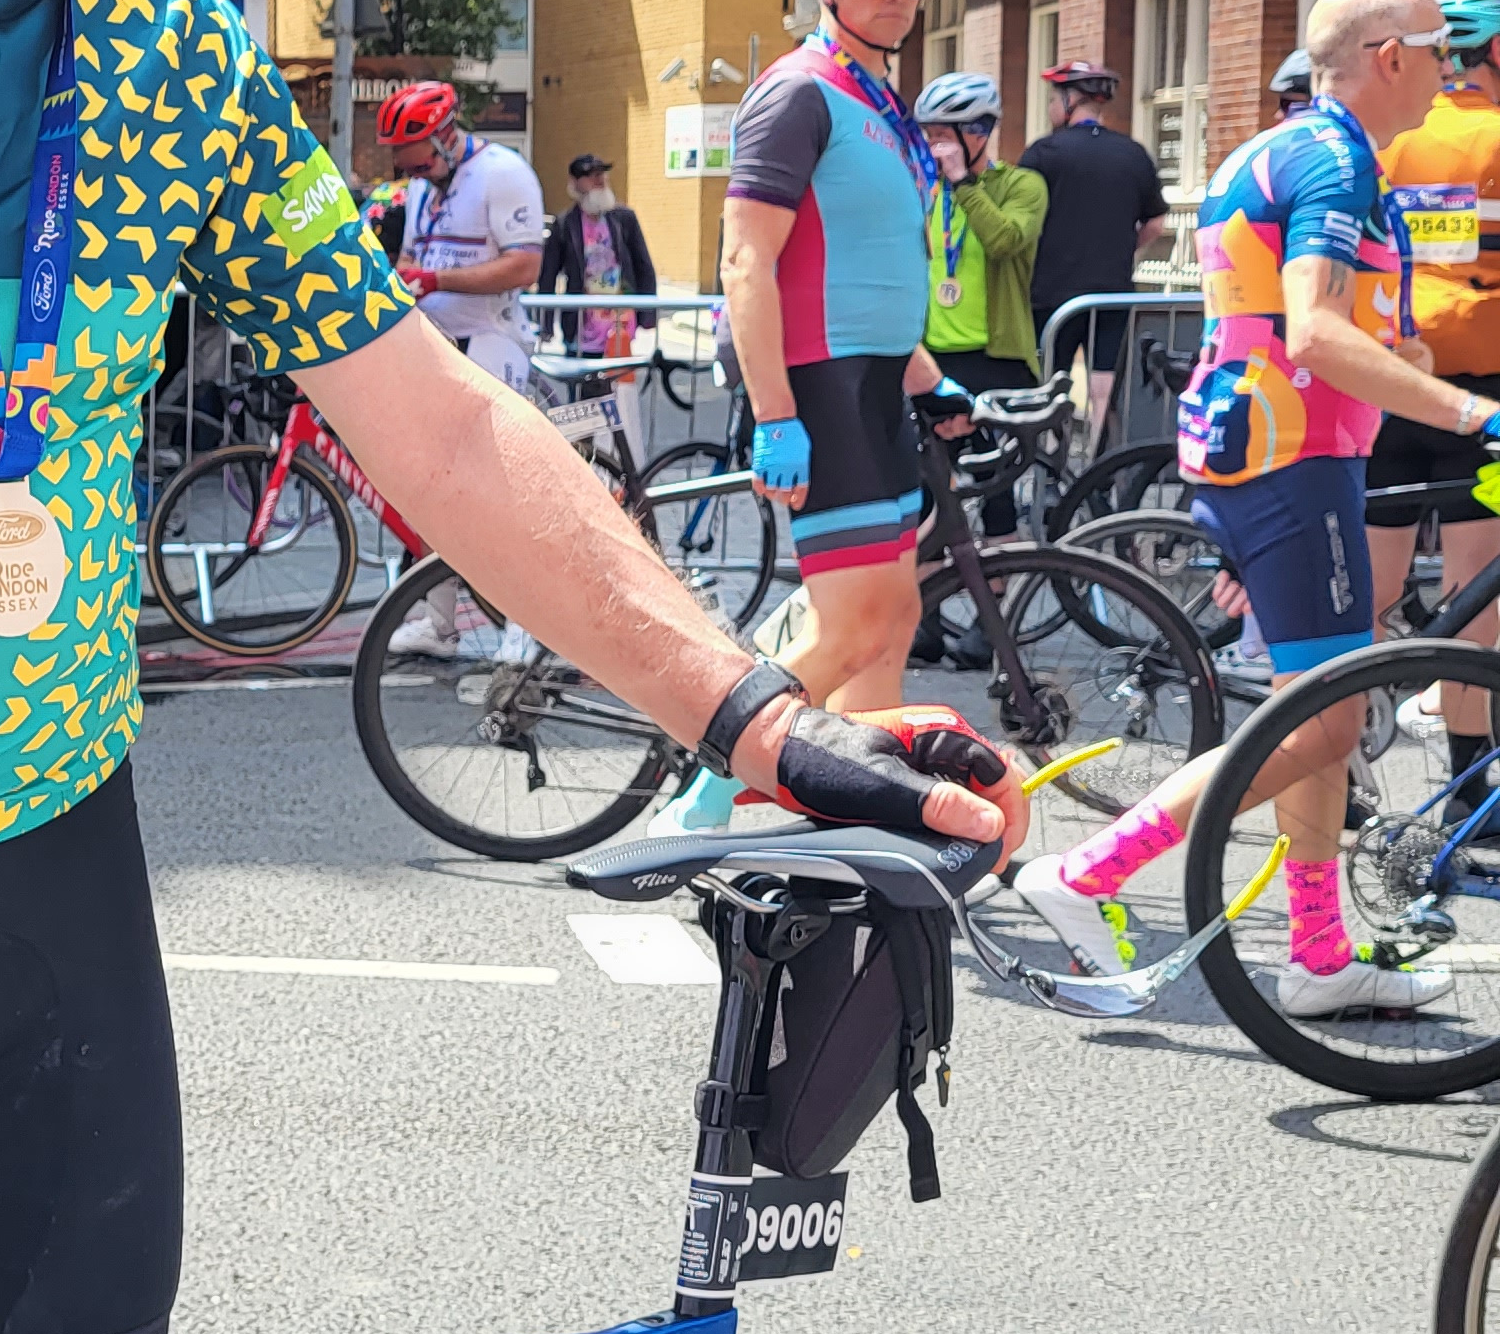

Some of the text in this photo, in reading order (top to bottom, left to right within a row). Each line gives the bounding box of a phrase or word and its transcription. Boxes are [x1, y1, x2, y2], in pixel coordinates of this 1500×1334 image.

[57, 172, 70, 210] ESSEX
[34, 272, 53, 310] Ford
[314, 430, 386, 518] CANYON
